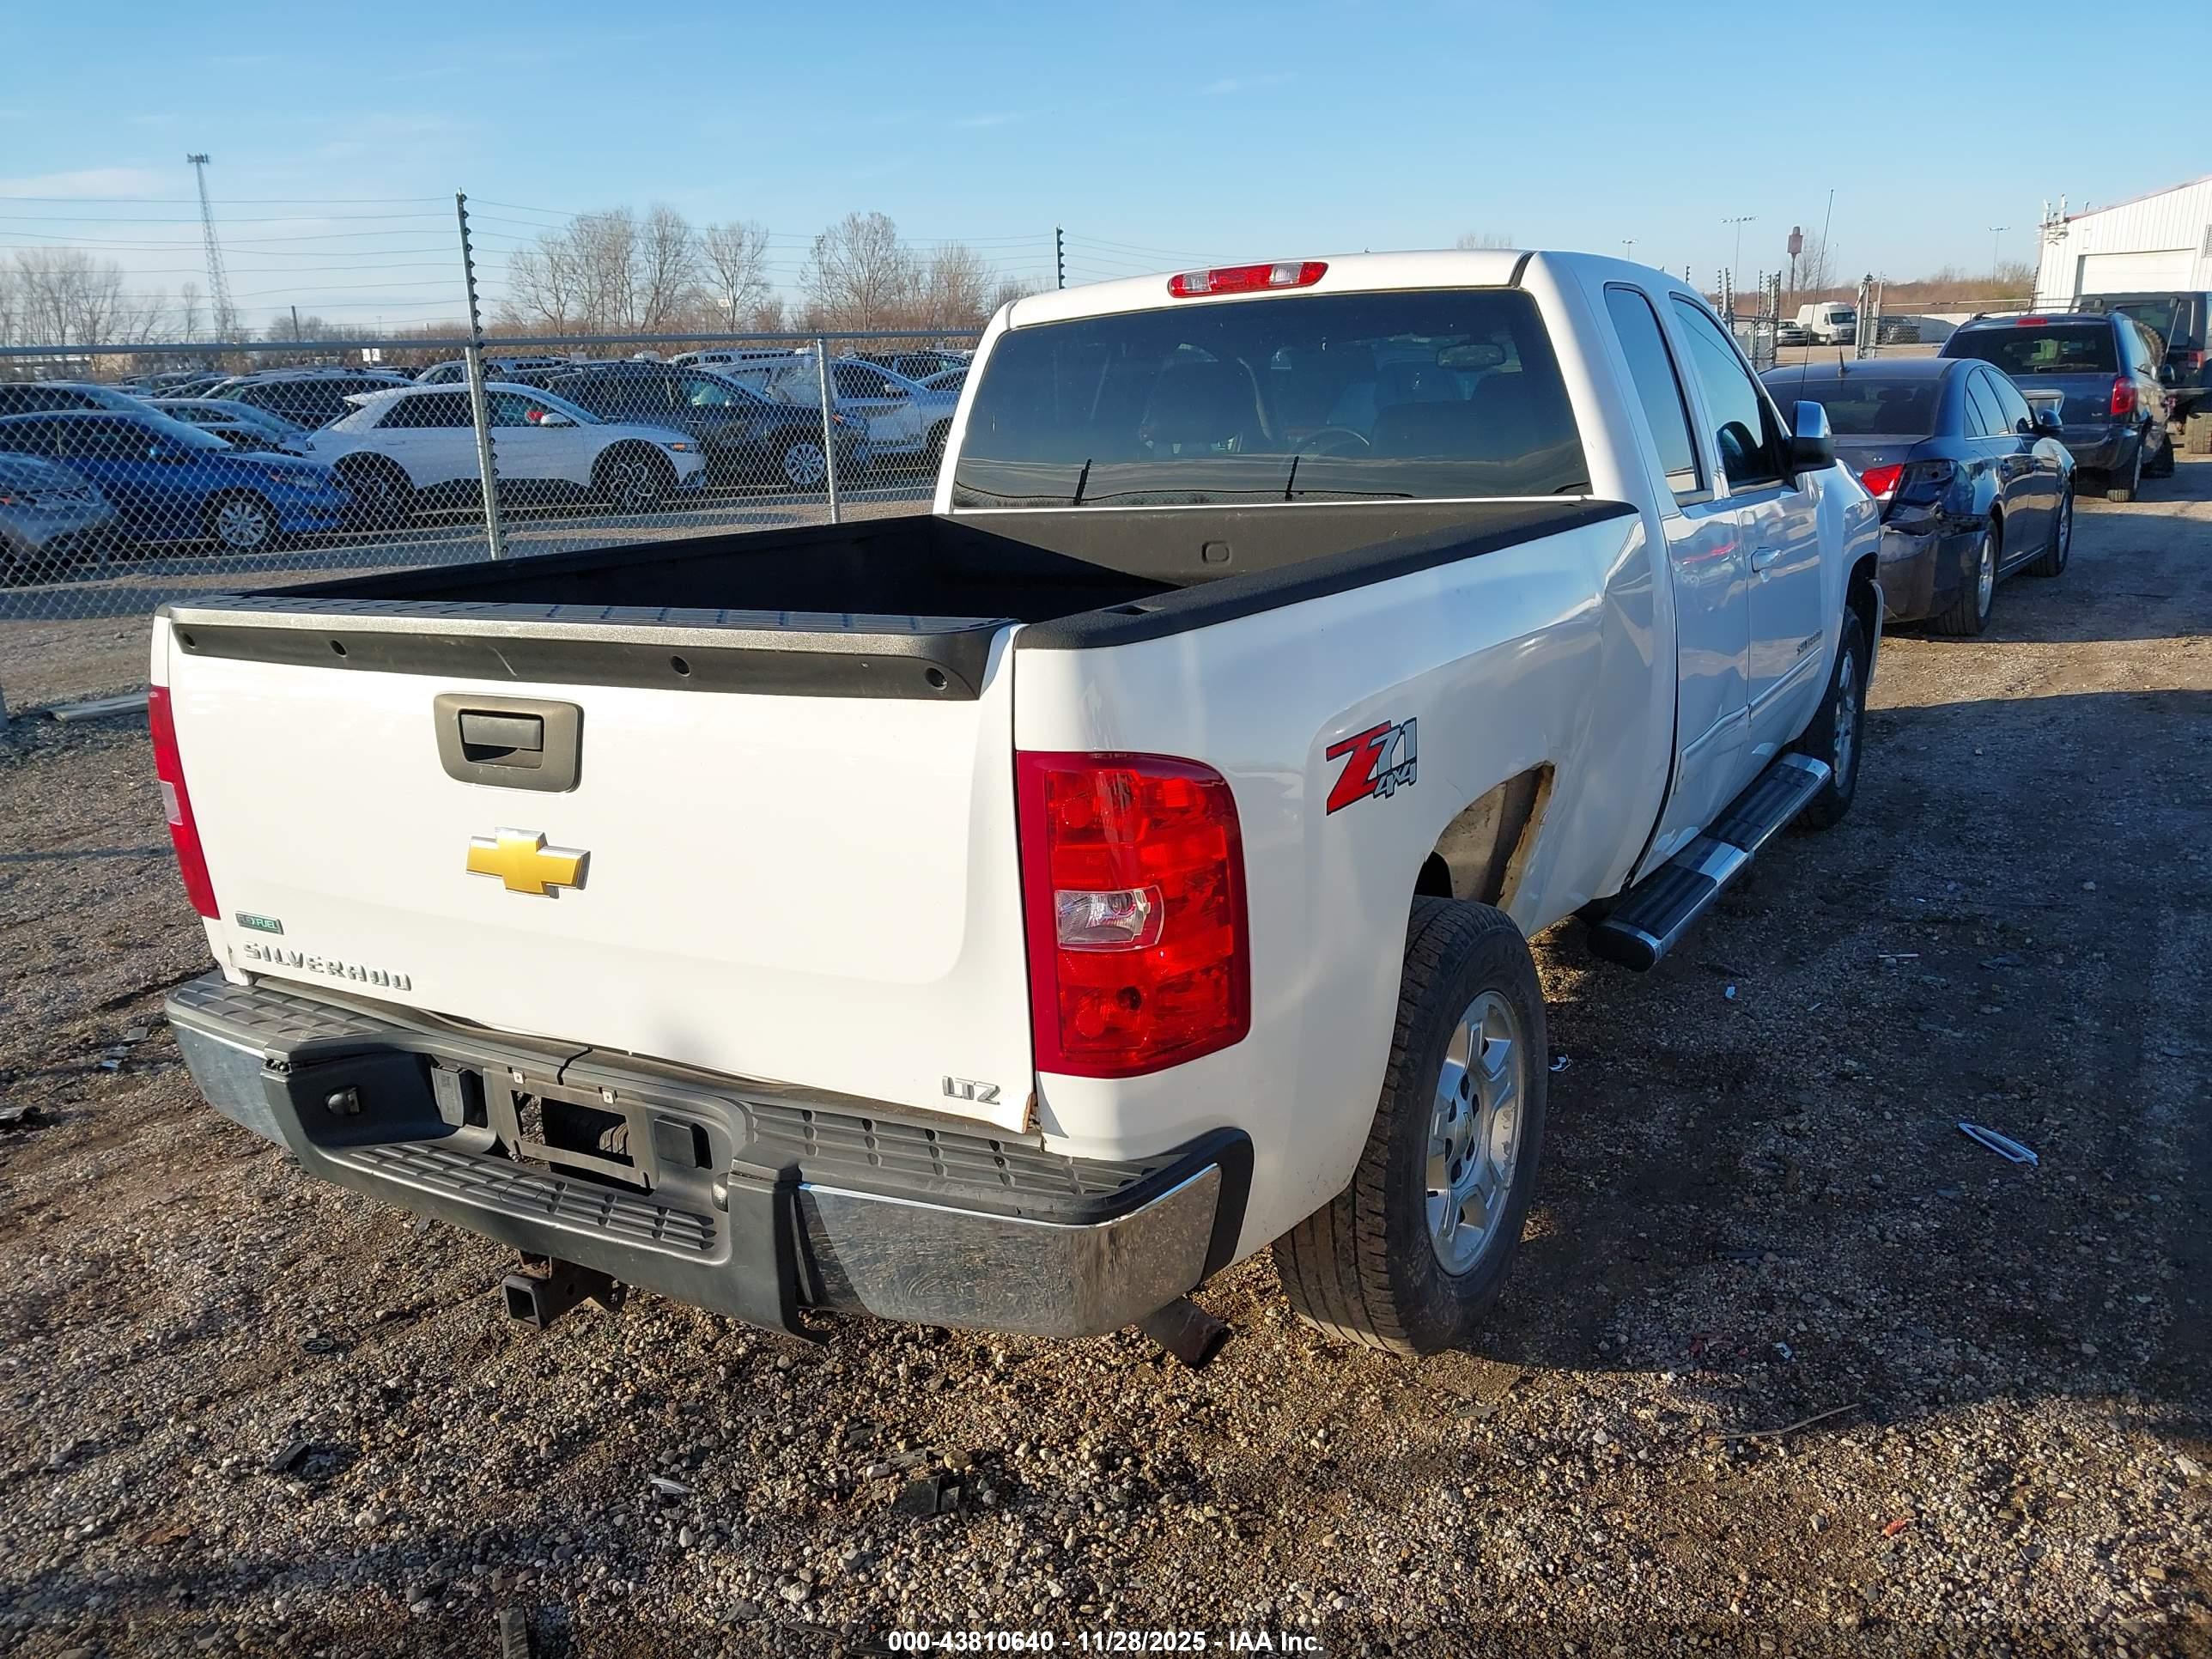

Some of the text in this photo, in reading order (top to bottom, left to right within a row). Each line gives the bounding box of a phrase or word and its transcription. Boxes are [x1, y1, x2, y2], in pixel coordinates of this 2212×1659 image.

[1326, 716, 1418, 816] Z71
[243, 941, 412, 992] SILVERADO
[941, 1074, 1001, 1106] LTZ
